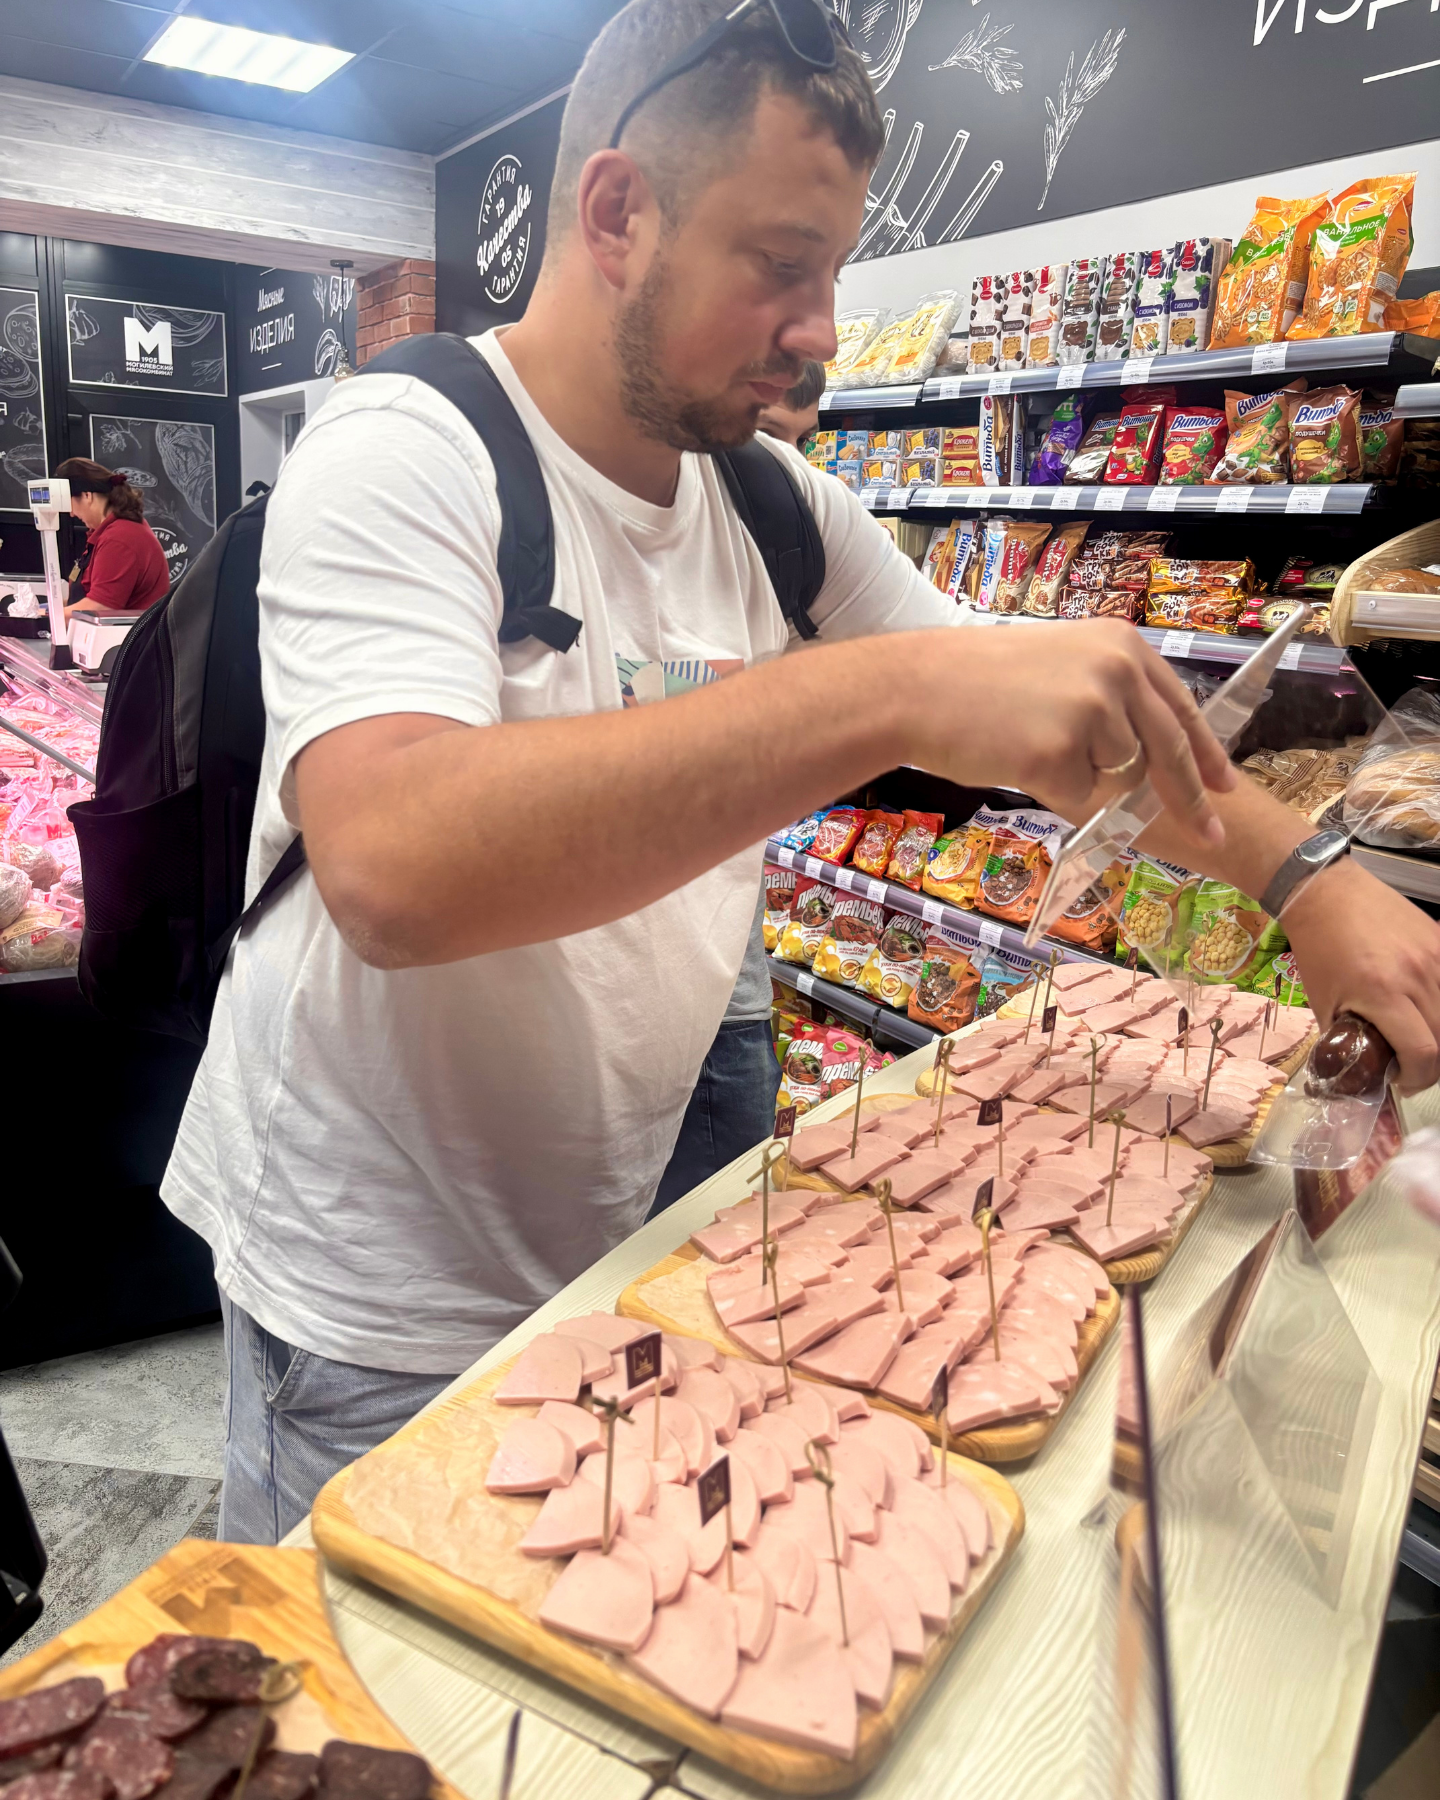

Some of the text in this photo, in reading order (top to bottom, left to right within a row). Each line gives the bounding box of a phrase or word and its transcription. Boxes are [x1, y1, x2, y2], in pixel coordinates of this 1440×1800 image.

[482, 165, 516, 224] ГАРАНТИЯ
[495, 197, 505, 218] 19
[476, 184, 532, 276] Качества
[492, 235, 526, 294] ГАРАНТИЯ
[502, 244, 513, 268] 05
[257, 287, 285, 312] Мясные
[249, 313, 295, 355] ИЗДЕЛИЯ
[126, 361, 173, 371] МОГИЛЕВСКИЙ
[1091, 419, 1120, 432] Витош
[1170, 413, 1223, 431] Витьба
[1359, 410, 1393, 428] тьба
[982, 415, 994, 472] Витьба
[1295, 430, 1326, 438] ПОДУШЕЧКИ
[950, 533, 973, 583] Витьба
[765, 871, 797, 889] ремь
[797, 883, 838, 909] премь
[831, 898, 884, 931] ремьер
[885, 914, 929, 943] ремь
